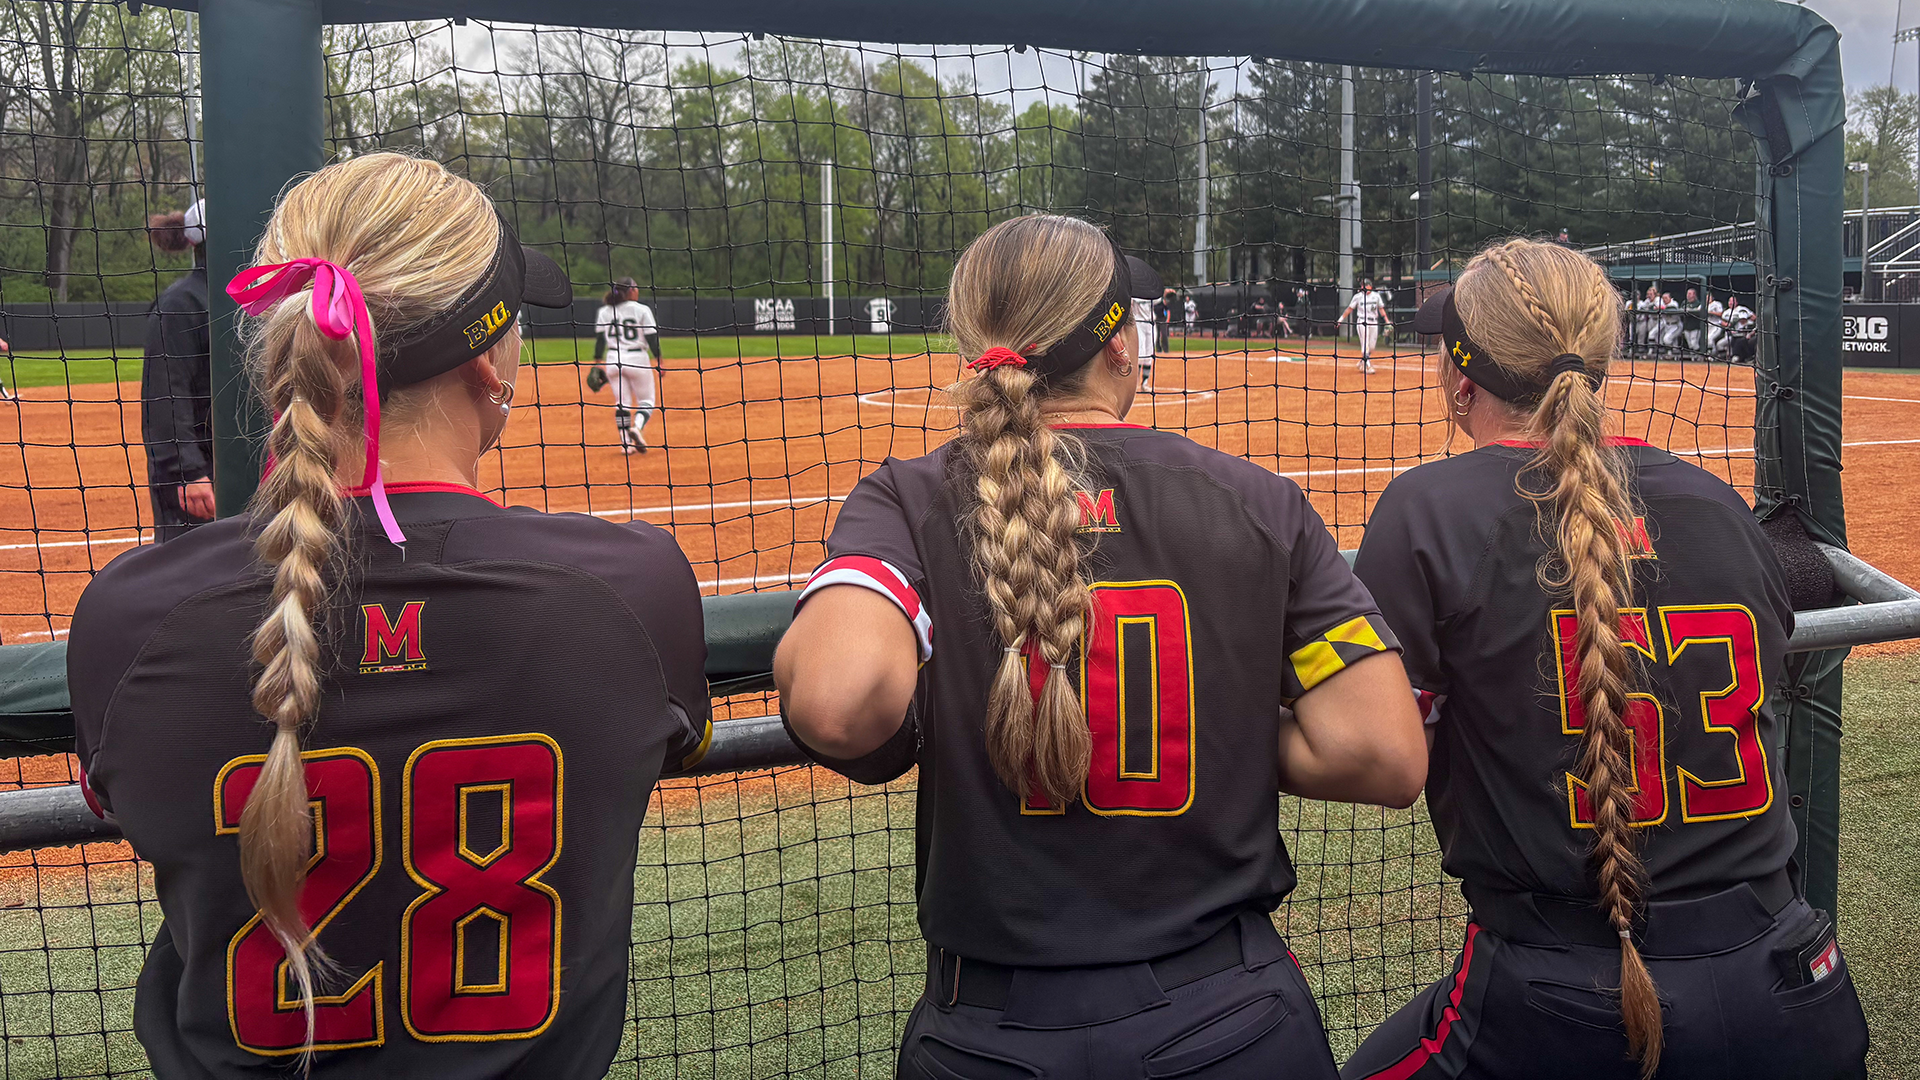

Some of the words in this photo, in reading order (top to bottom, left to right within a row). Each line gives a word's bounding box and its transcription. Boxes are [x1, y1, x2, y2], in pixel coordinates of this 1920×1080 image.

[608, 318, 638, 341] 46
[755, 298, 795, 312] NCAA
[877, 308, 885, 320] 9
[1073, 489, 1120, 527] M
[360, 601, 426, 665] M
[1020, 579, 1196, 817] 0
[1551, 603, 1774, 829] 53
[213, 732, 564, 1057] 28
